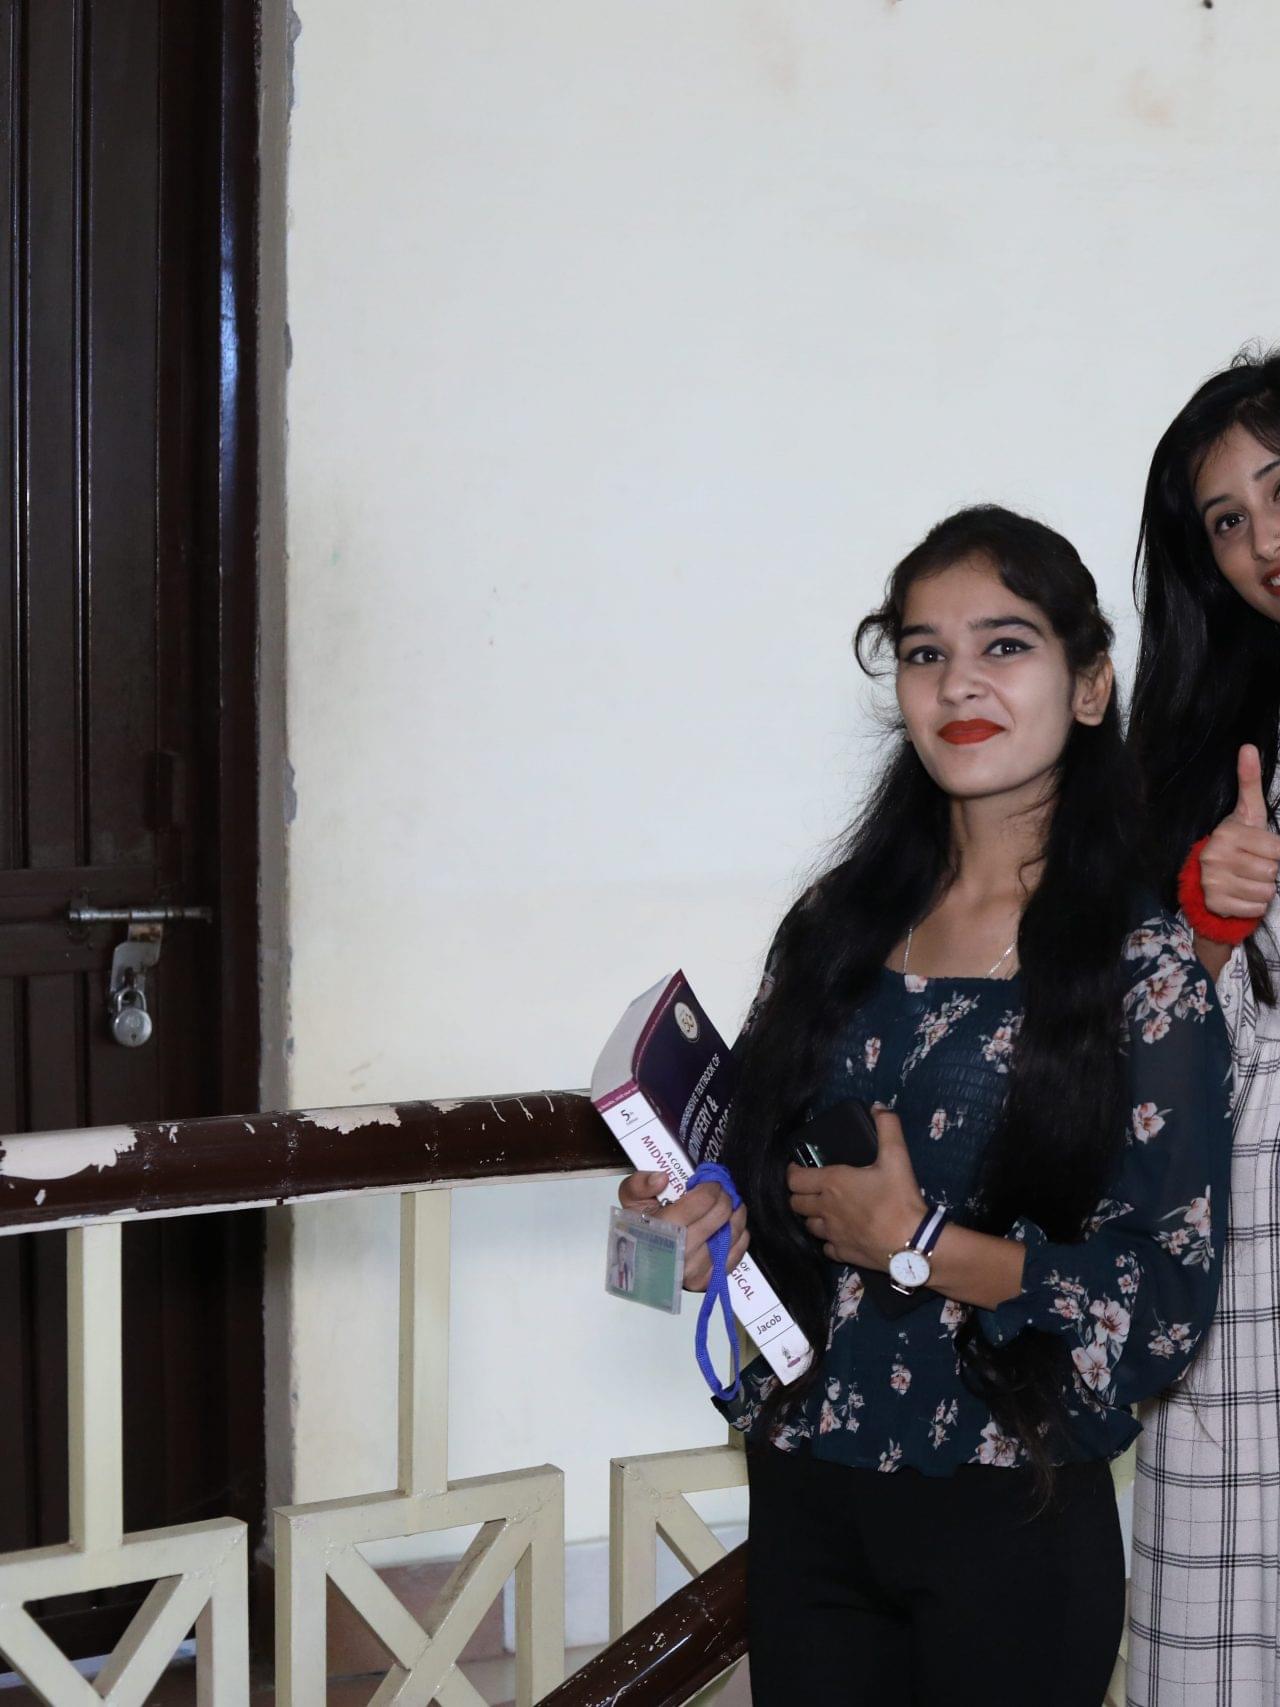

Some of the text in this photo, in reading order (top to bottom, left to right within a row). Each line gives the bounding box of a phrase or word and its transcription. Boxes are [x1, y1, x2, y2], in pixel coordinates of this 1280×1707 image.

[694, 1062, 717, 1096] TEXTBOOK
[711, 1052, 721, 1068] OF
[706, 1094, 719, 1113] &
[665, 1151, 673, 1159] A
[740, 1261, 751, 1272] OF
[731, 1267, 755, 1301] GICAL
[757, 1313, 782, 1335] Jacob
